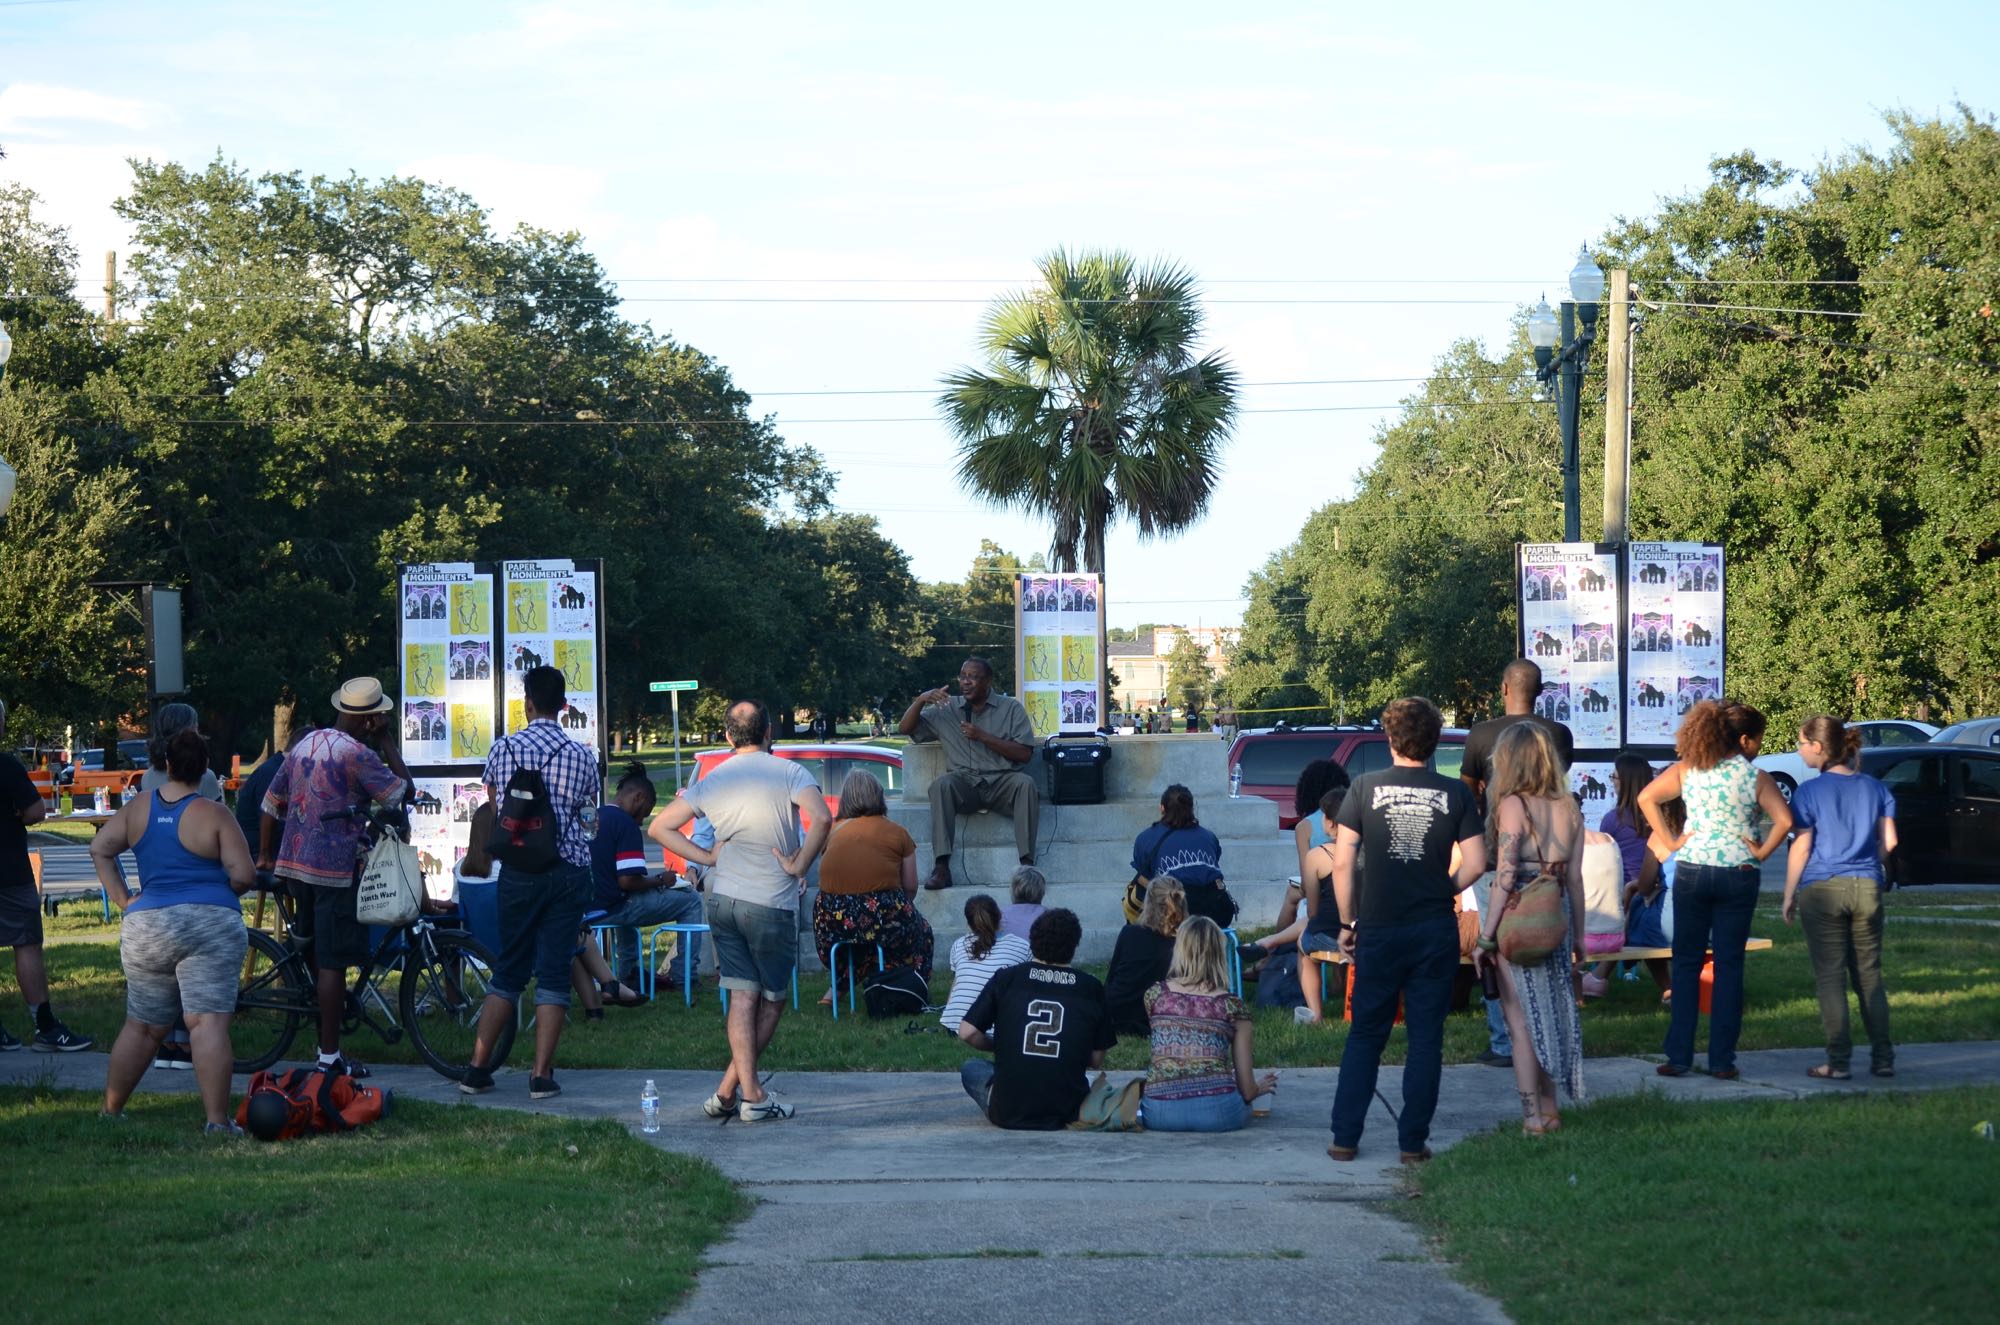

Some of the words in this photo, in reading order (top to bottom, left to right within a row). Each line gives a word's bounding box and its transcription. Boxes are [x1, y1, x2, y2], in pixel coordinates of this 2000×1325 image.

[1526, 546, 1554, 554] PAPER
[1633, 544, 1662, 552] PAPER
[1529, 554, 1587, 563] MONUMENTS
[406, 565, 434, 573] PAPER
[508, 563, 536, 571] PAPER
[409, 573, 467, 581] MONUMENTS
[511, 570, 567, 579] MONUMENTS
[379, 890, 397, 899] Ward
[1029, 967, 1077, 985] BROOKS
[1023, 999, 1065, 1058] 2
